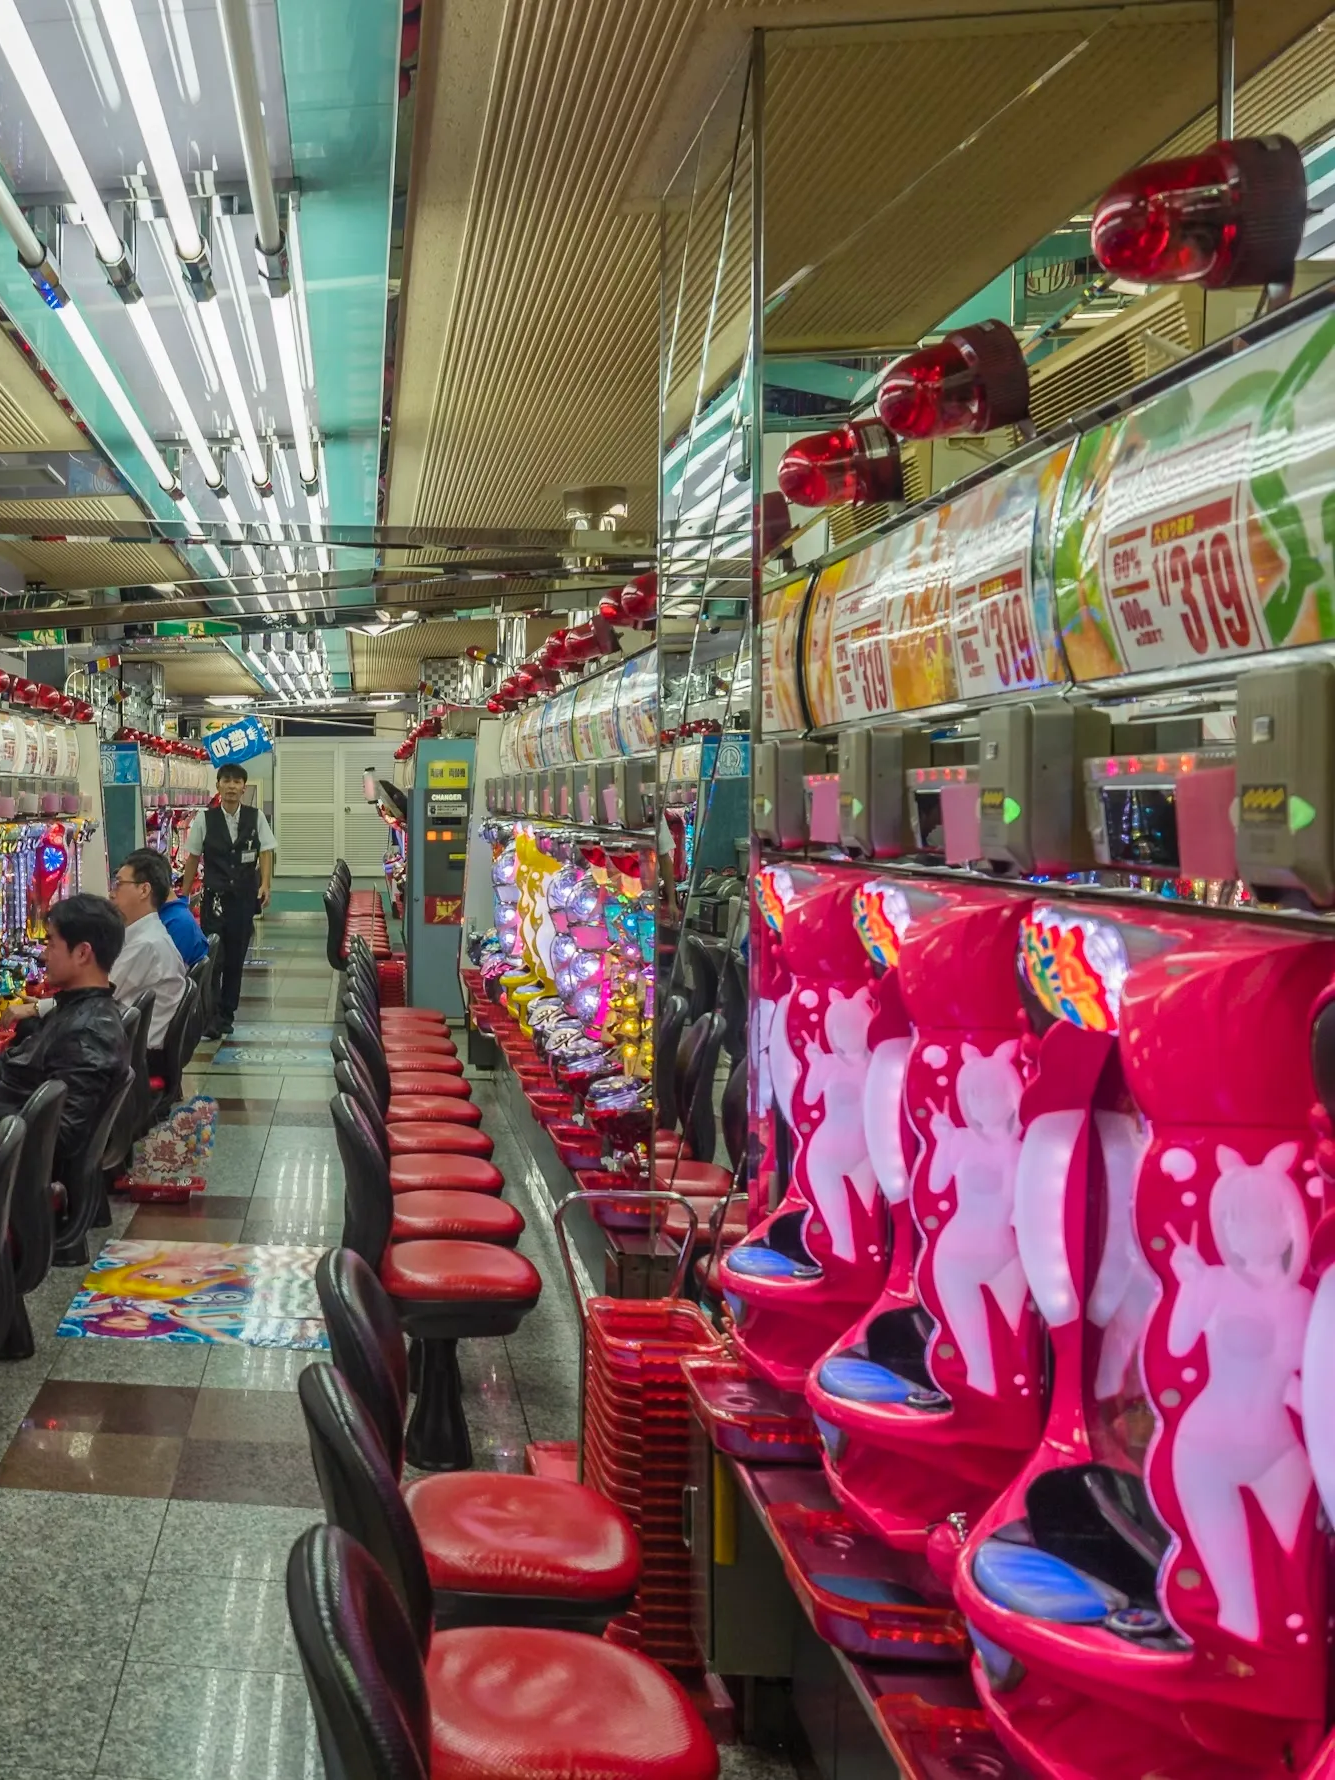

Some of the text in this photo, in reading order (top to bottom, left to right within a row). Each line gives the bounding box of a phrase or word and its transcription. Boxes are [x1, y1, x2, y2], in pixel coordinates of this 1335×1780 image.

[980, 593, 1036, 688] 1/319
[1151, 532, 1251, 656] 1/319
[431, 793, 463, 801] CHANGER
